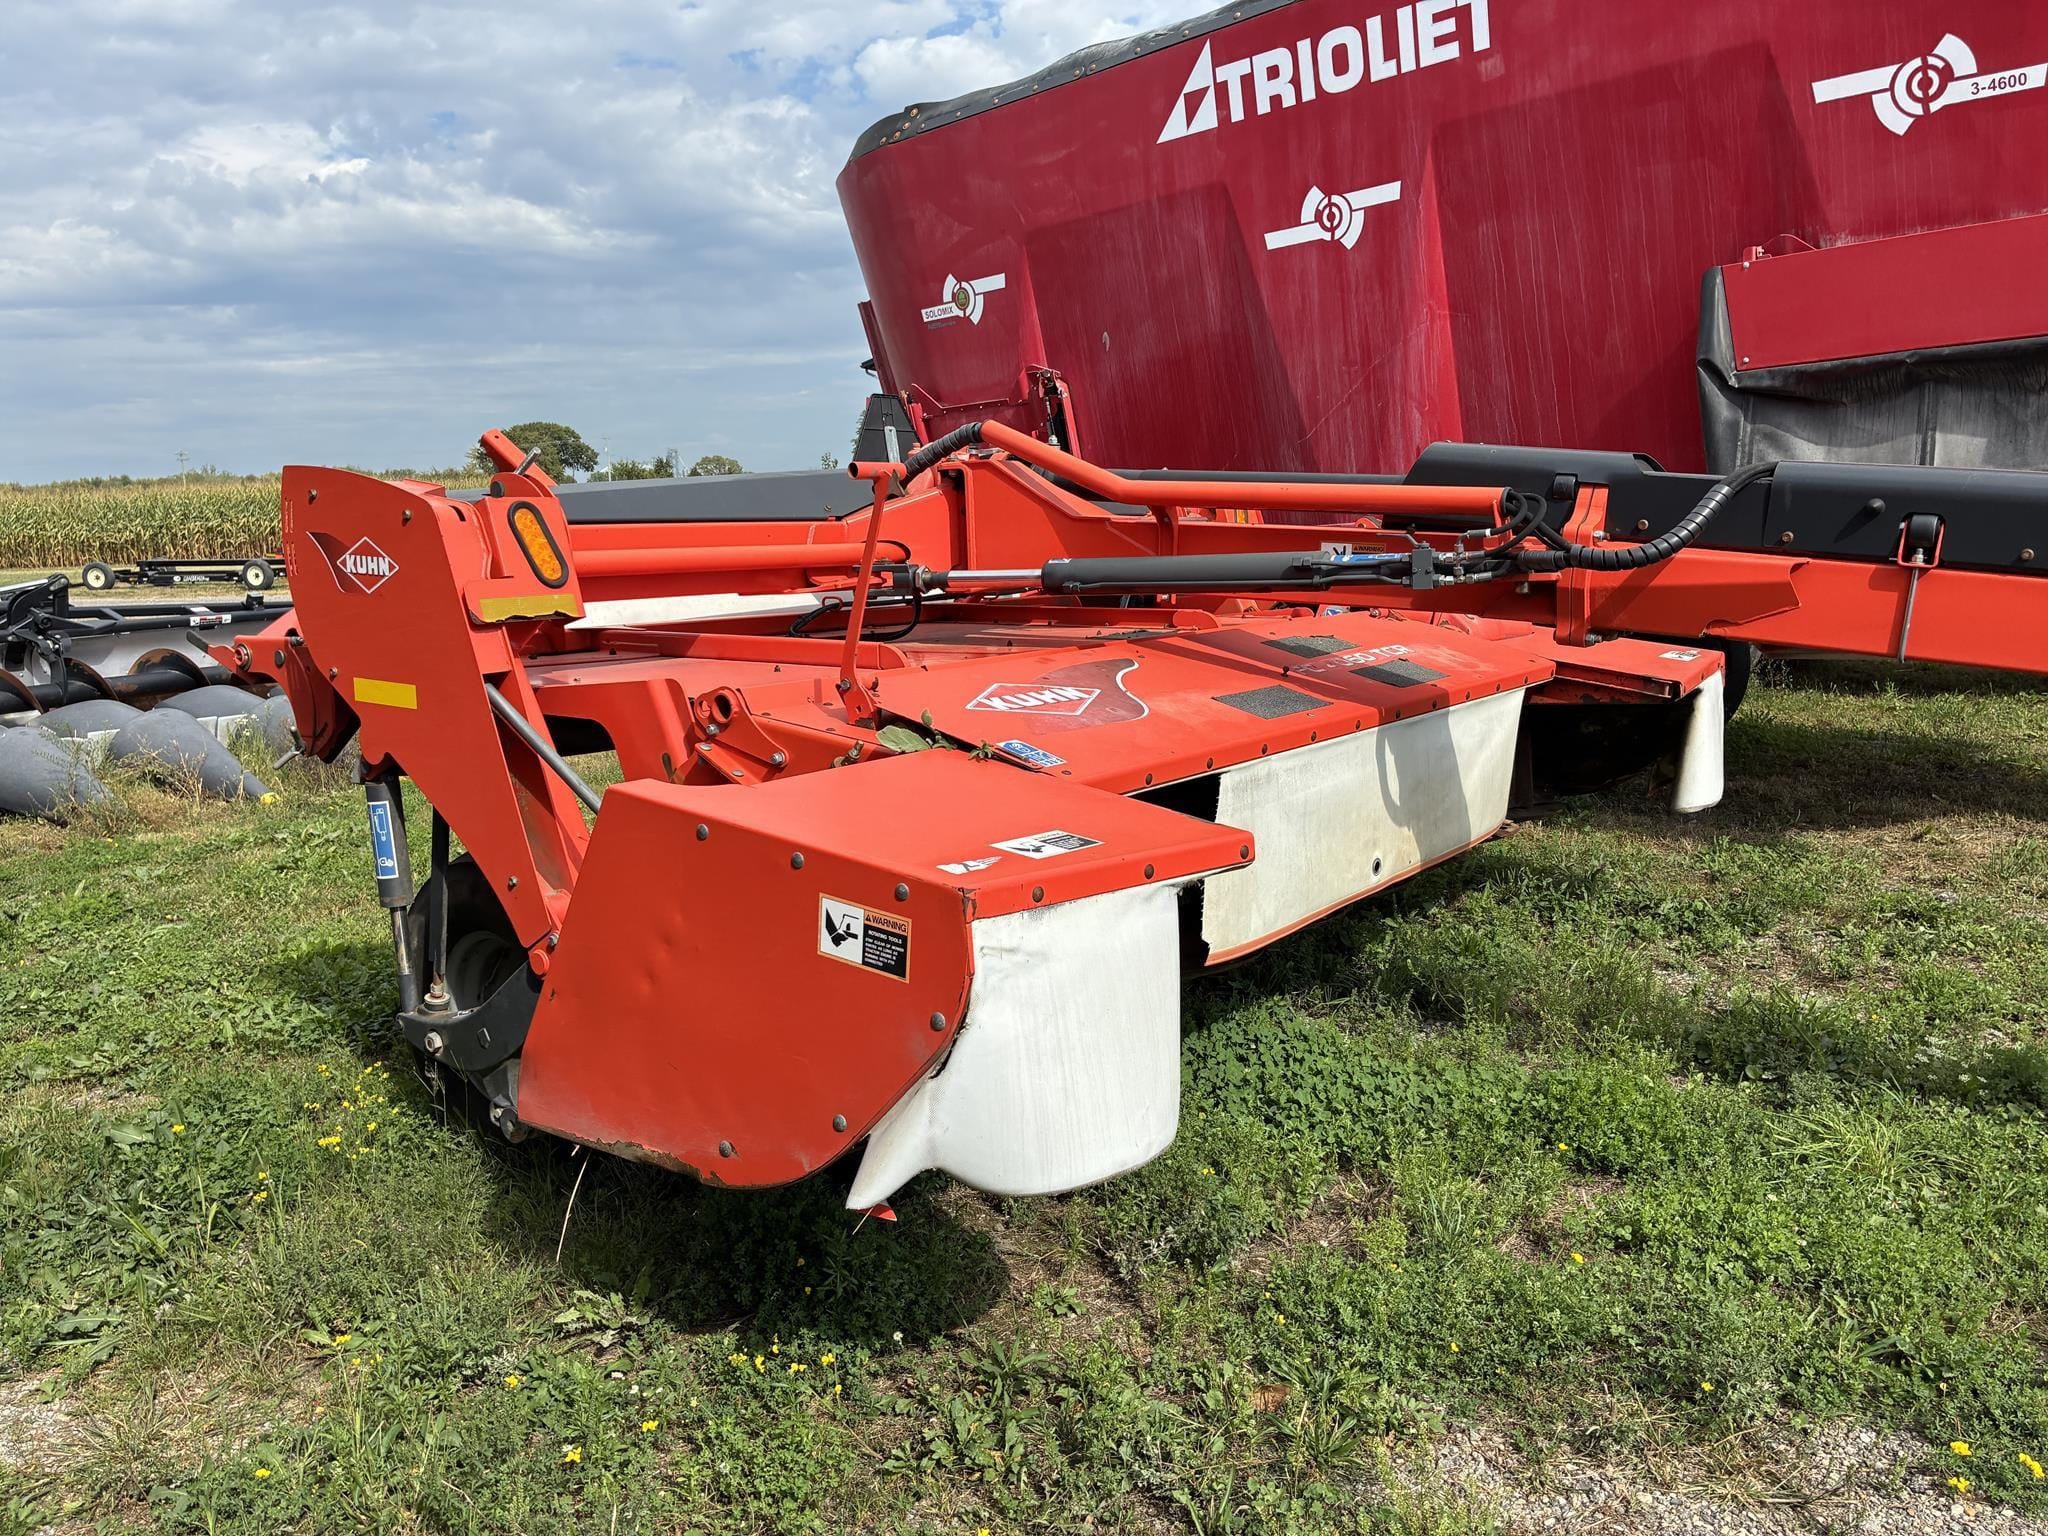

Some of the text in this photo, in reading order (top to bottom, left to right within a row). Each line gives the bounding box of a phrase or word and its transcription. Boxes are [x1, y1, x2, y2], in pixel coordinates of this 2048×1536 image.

[1216, 0, 1490, 123] TRIOLIET
[1970, 72, 2028, 96] 3-4600
[925, 305, 954, 319] SOLOMIX
[345, 554, 390, 576] KUHN
[976, 686, 1089, 711] KUHN
[871, 914, 907, 932] WARNING
